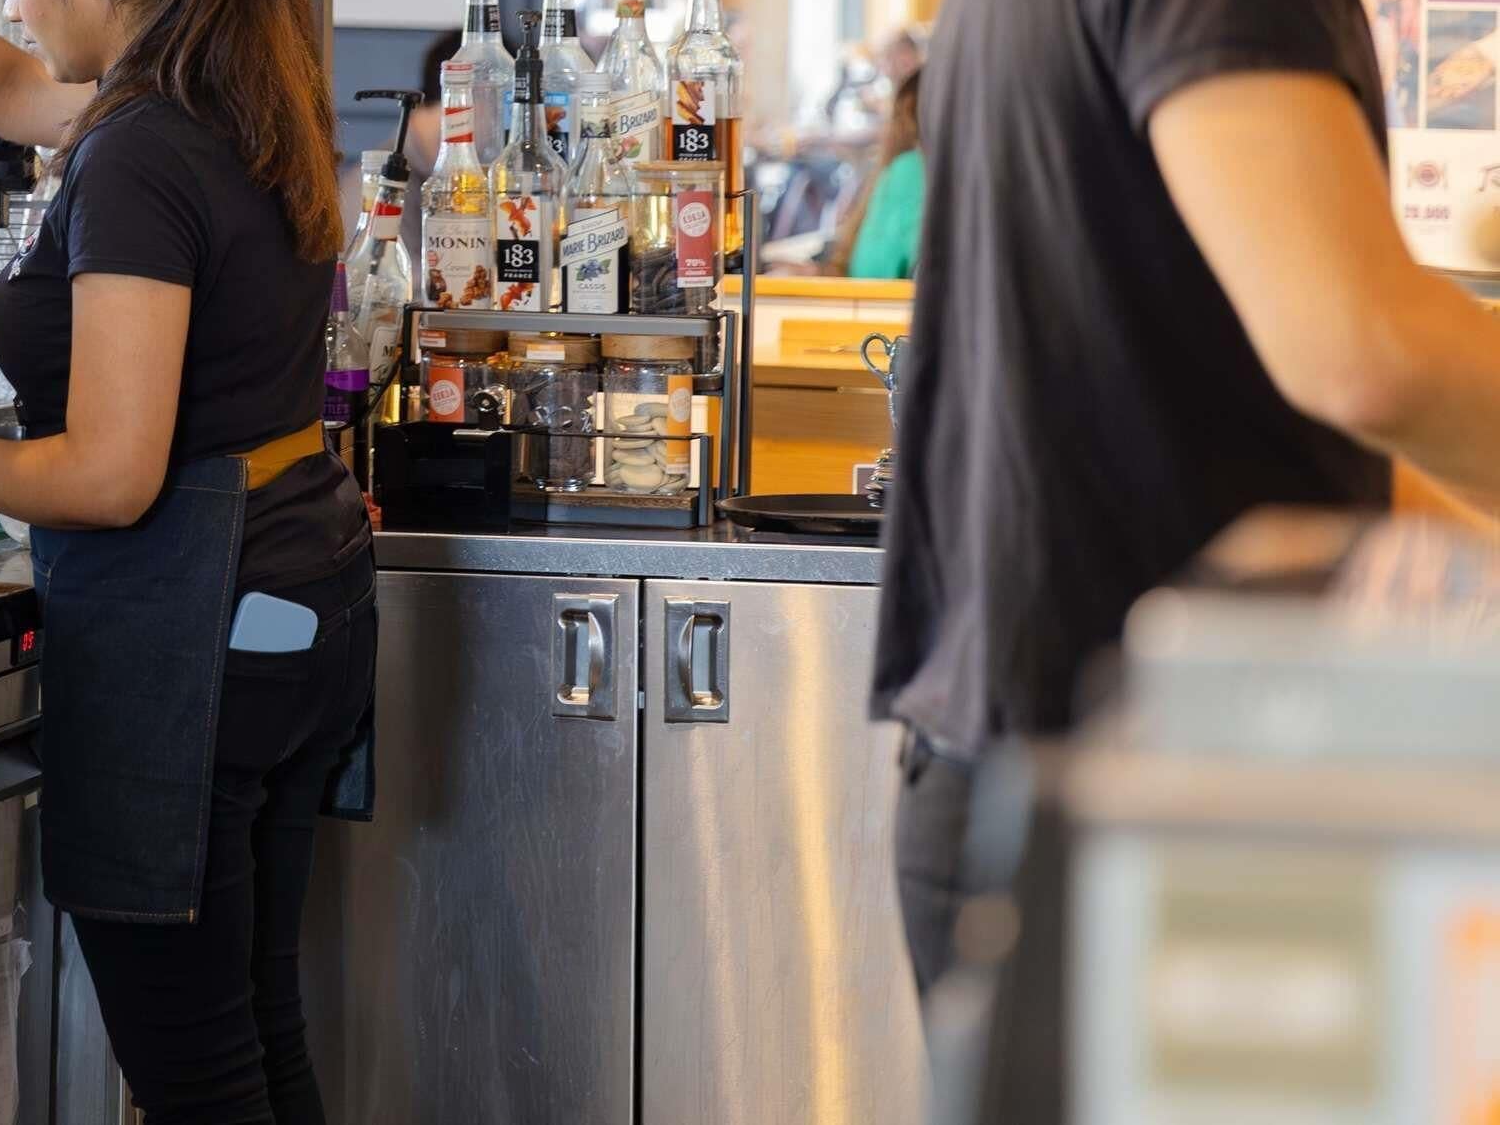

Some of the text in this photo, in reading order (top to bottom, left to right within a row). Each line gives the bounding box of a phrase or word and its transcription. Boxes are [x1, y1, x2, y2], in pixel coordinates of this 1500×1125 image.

[428, 236, 487, 250] MONIN
[563, 226, 625, 255] MARIE BRIZARD
[579, 283, 606, 291] CASSIS
